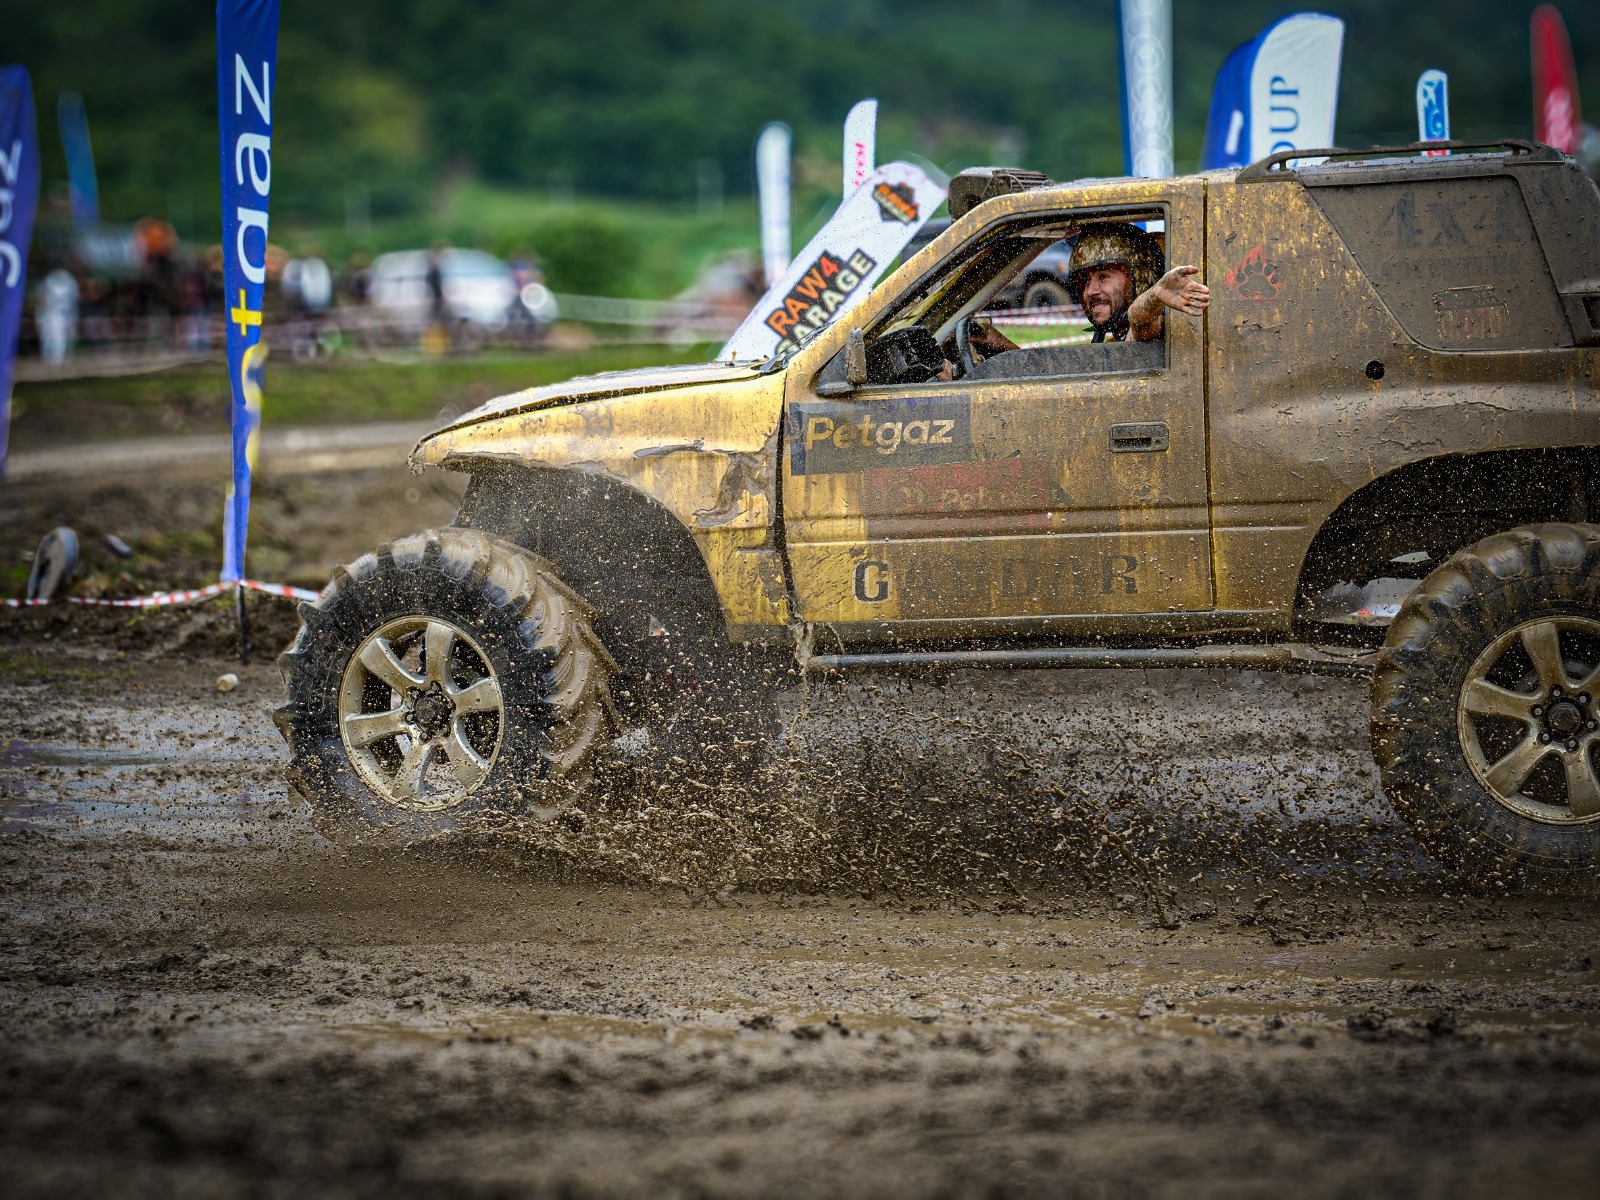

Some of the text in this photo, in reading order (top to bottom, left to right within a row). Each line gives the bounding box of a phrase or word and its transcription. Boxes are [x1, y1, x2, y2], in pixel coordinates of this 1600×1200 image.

[230, 53, 273, 475] tgaz
[767, 256, 840, 337] RAW4
[805, 414, 956, 455] Petgaz
